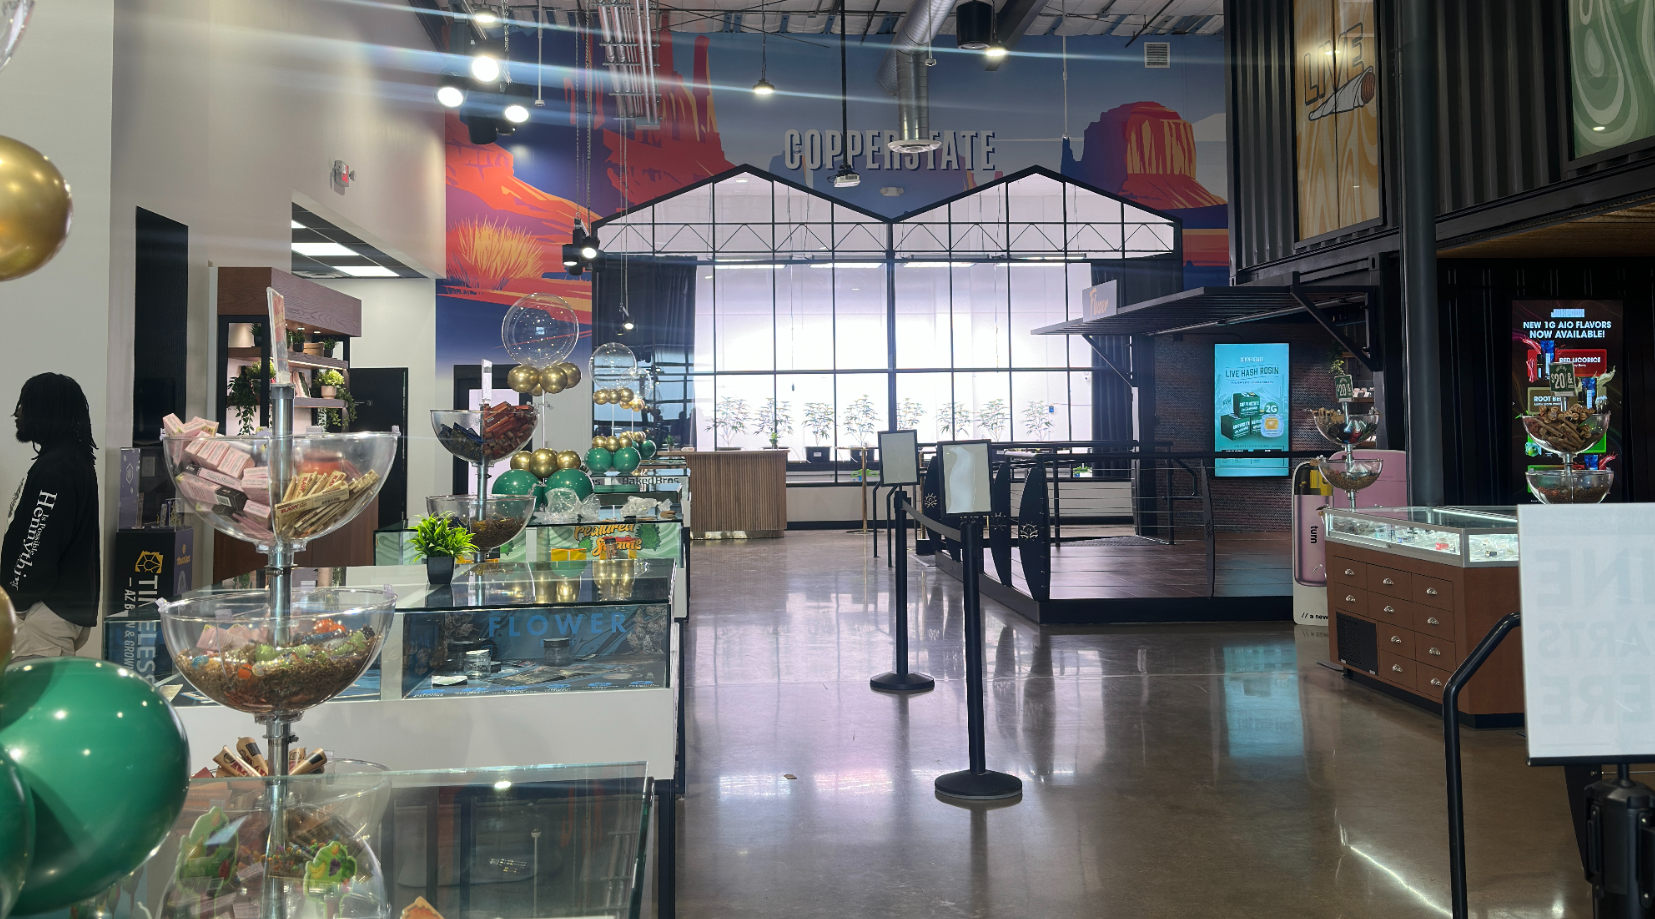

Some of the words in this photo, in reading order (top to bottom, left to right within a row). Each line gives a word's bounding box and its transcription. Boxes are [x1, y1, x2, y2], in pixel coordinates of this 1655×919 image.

[1304, 22, 1364, 106] LIVE
[1522, 321, 1542, 329] NEW
[1544, 321, 1556, 329] 1G
[1558, 321, 1574, 329] AIO
[1575, 321, 1612, 329] FLAVORS
[1529, 330, 1553, 339] NOW
[1554, 330, 1606, 339] AVAILABLE!
[1225, 370, 1240, 378] LIVE
[1241, 367, 1259, 378] HASH
[1260, 366, 1279, 375] ROSIN
[1551, 372, 1566, 389] $20
[1265, 405, 1278, 413] 2G
[280, 503, 300, 514] RAW
[1310, 525, 1319, 544] turn
[124, 588, 136, 602] AZ
[136, 575, 158, 686] TIELES
[488, 612, 627, 638] FLOWER
[124, 630, 136, 638] &
